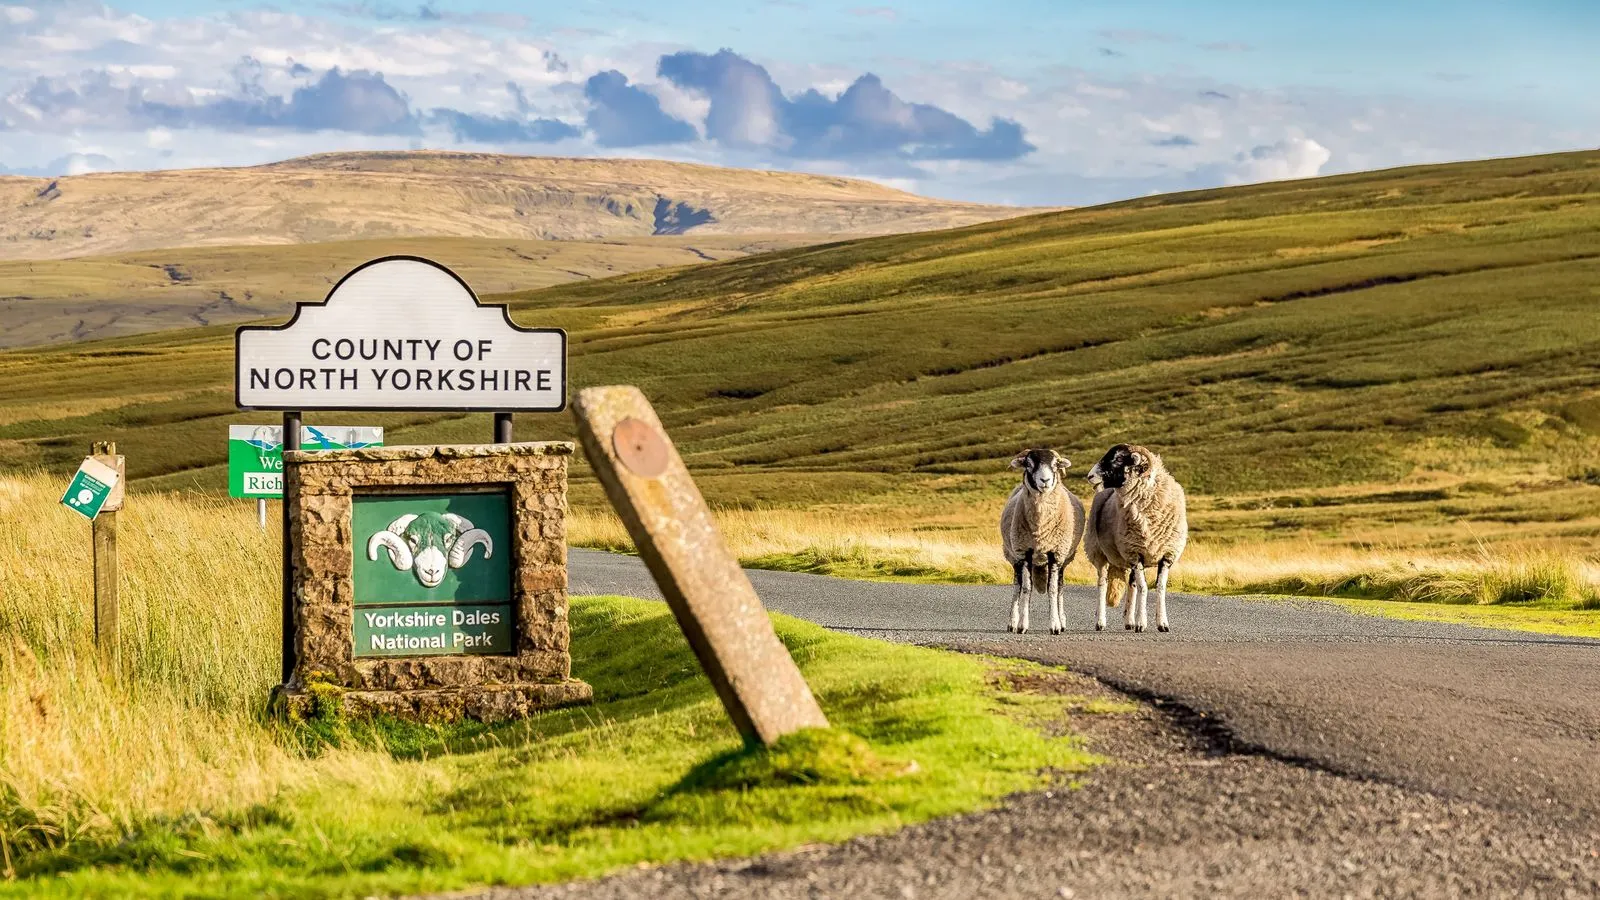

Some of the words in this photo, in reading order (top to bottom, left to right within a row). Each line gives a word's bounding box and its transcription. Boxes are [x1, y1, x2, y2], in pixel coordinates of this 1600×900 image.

[311, 338, 442, 361] COUNTY
[453, 339, 493, 361] OF
[250, 367, 358, 390] NORTH
[371, 368, 552, 392] YORKSHIRE
[364, 611, 446, 628] Yorkshire
[452, 609, 500, 626] Dales
[371, 632, 446, 650] National
[453, 631, 493, 648] Park
